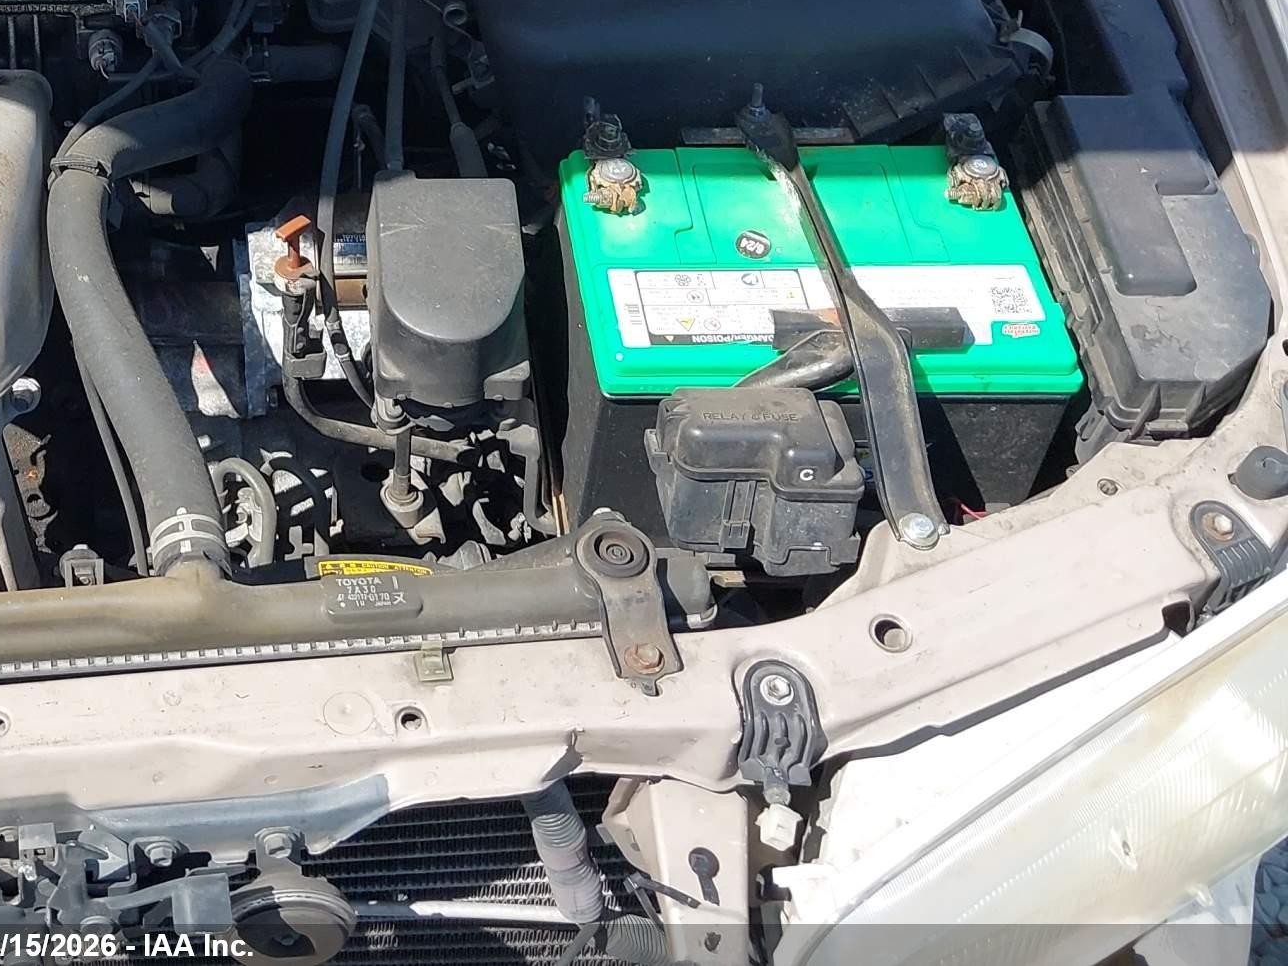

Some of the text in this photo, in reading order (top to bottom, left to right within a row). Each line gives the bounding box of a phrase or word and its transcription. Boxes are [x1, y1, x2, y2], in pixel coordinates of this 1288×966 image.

[702, 412, 747, 421] RELAY
[763, 413, 800, 423] FUSE
[799, 468, 815, 482] C
[336, 577, 382, 587] TOYOTA
